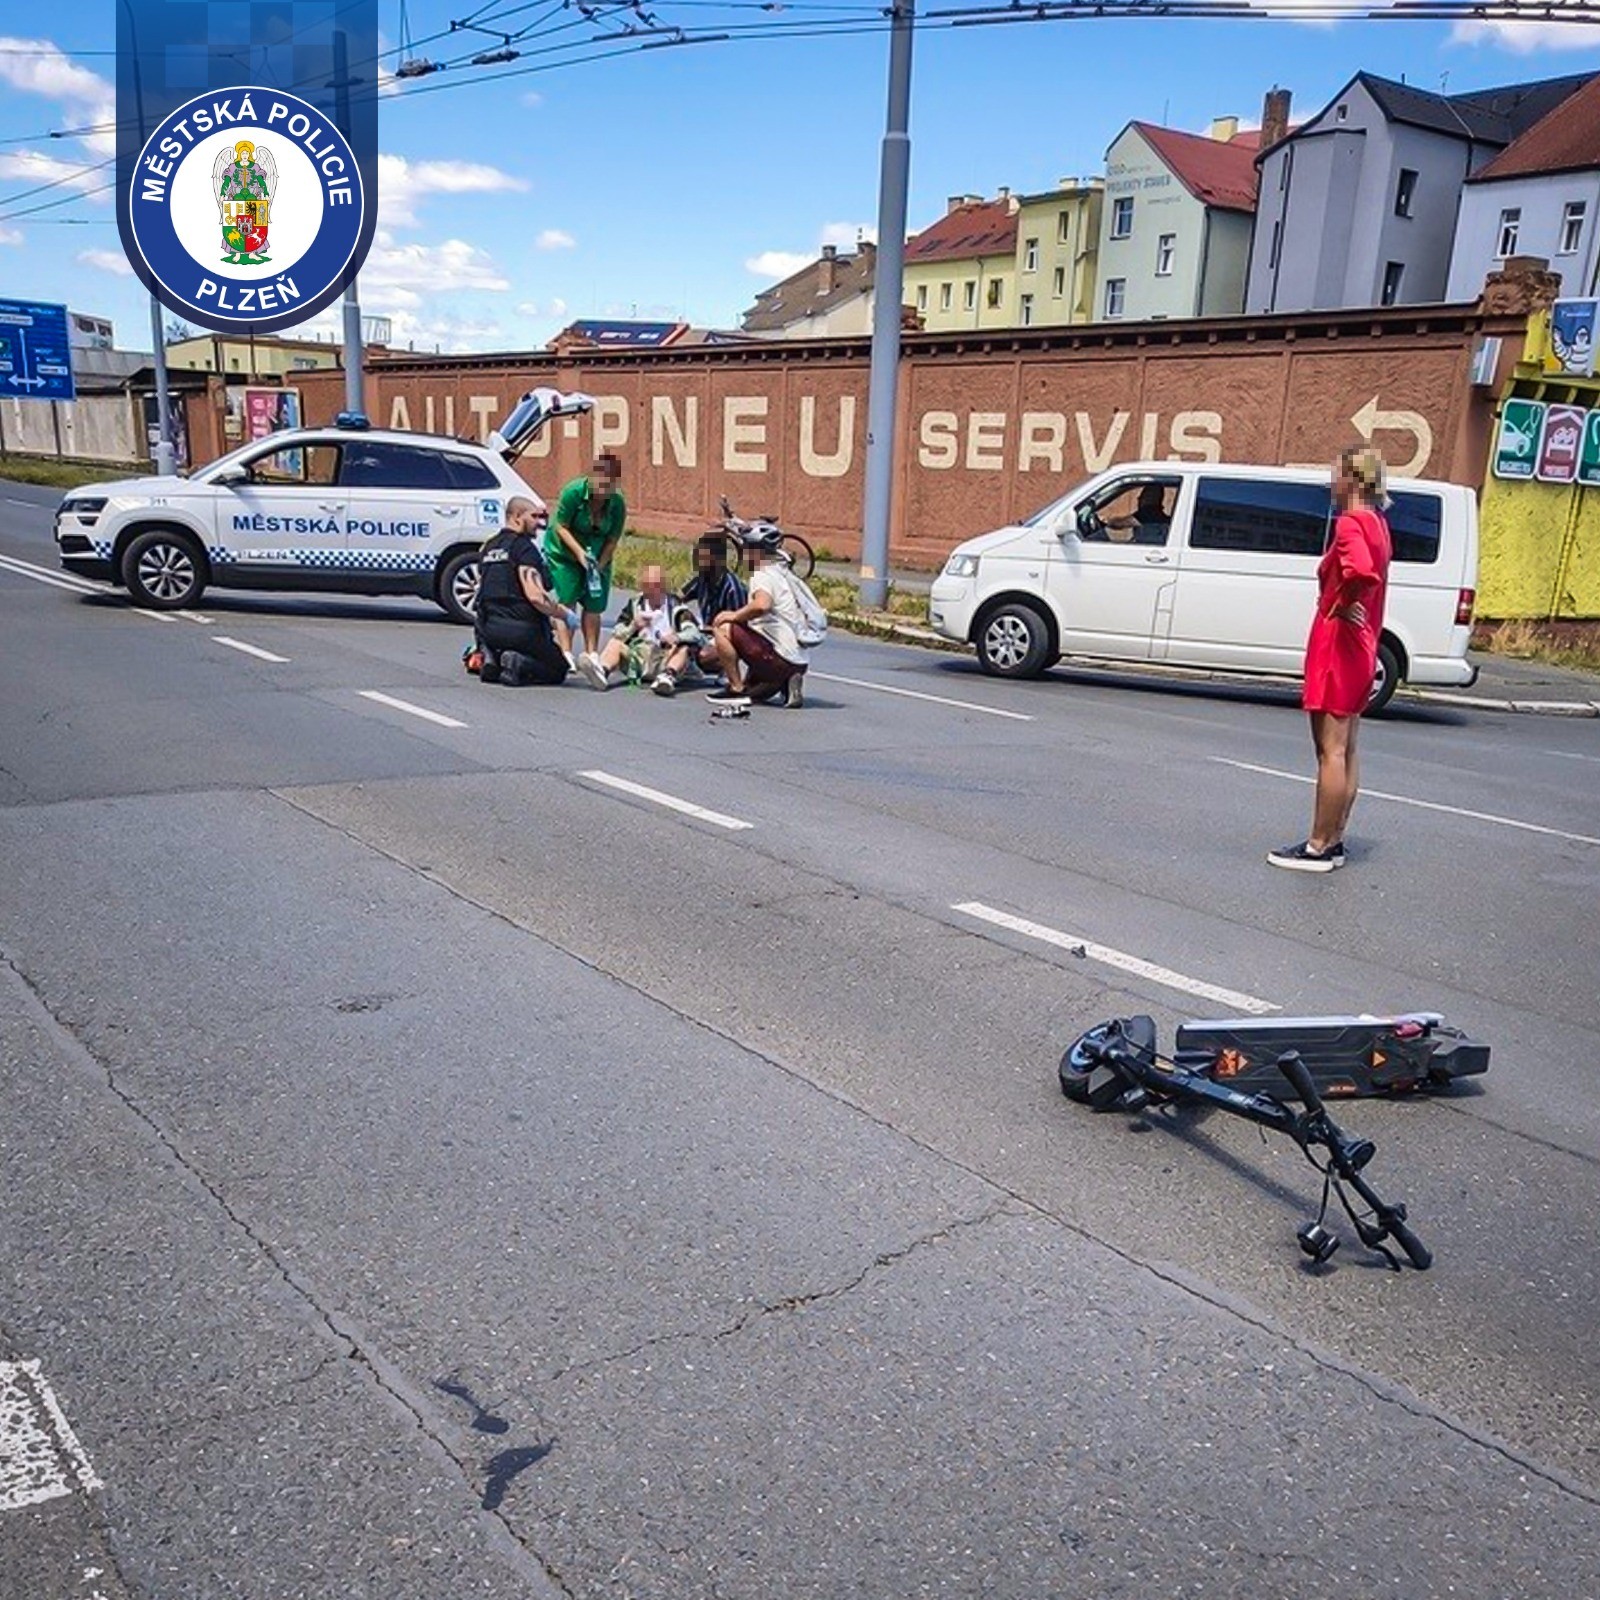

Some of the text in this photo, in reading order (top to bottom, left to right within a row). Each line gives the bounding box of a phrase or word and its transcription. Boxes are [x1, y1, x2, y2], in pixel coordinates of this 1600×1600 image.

[918, 410, 1222, 472] SERVIS
[233, 513, 430, 538] MĚSTSKÁ POLICIE
